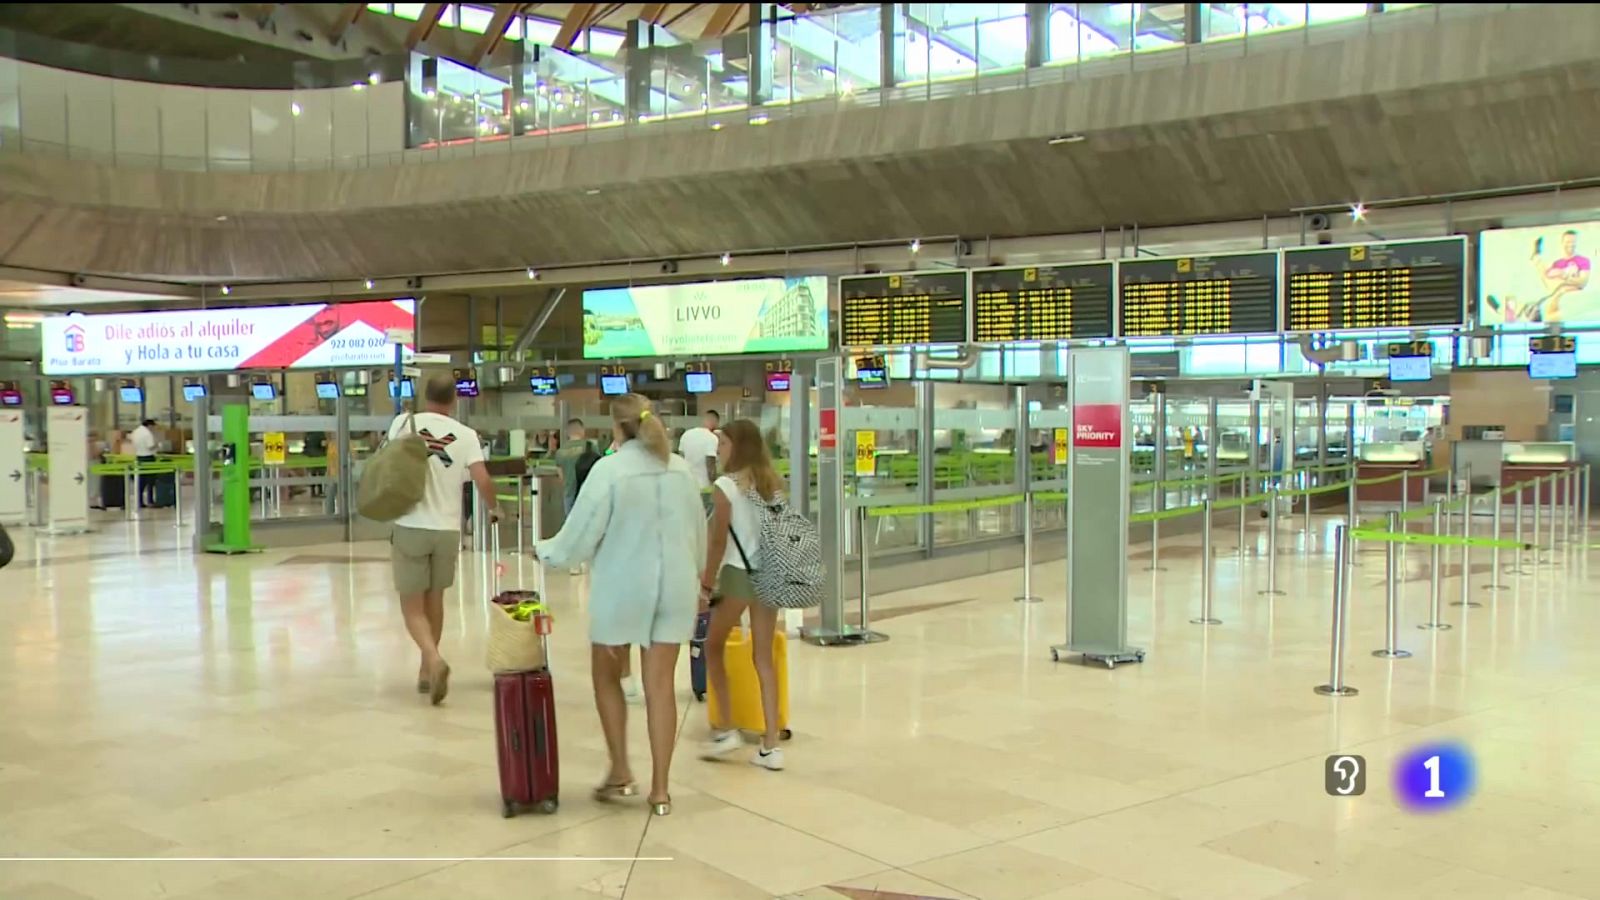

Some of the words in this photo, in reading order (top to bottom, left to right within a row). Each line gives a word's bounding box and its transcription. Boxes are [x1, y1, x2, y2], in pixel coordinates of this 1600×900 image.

[676, 305, 721, 322] LIVVO
[104, 323, 132, 341] Dile
[180, 320, 193, 338] al
[198, 317, 255, 341] alquiler
[330, 339, 346, 349] 922
[368, 337, 386, 347] 020
[1410, 342, 1430, 355] 14
[1552, 337, 1575, 352] 15
[124, 348, 133, 366] y
[138, 343, 170, 361] Hola
[174, 346, 183, 360] a
[187, 344, 202, 359] tu
[207, 344, 240, 359] casa
[612, 366, 625, 377] 10
[699, 363, 711, 374] 11
[777, 360, 791, 372] 12
[1076, 424, 1094, 432] SKY
[1076, 432, 1115, 441] PRIORITY
